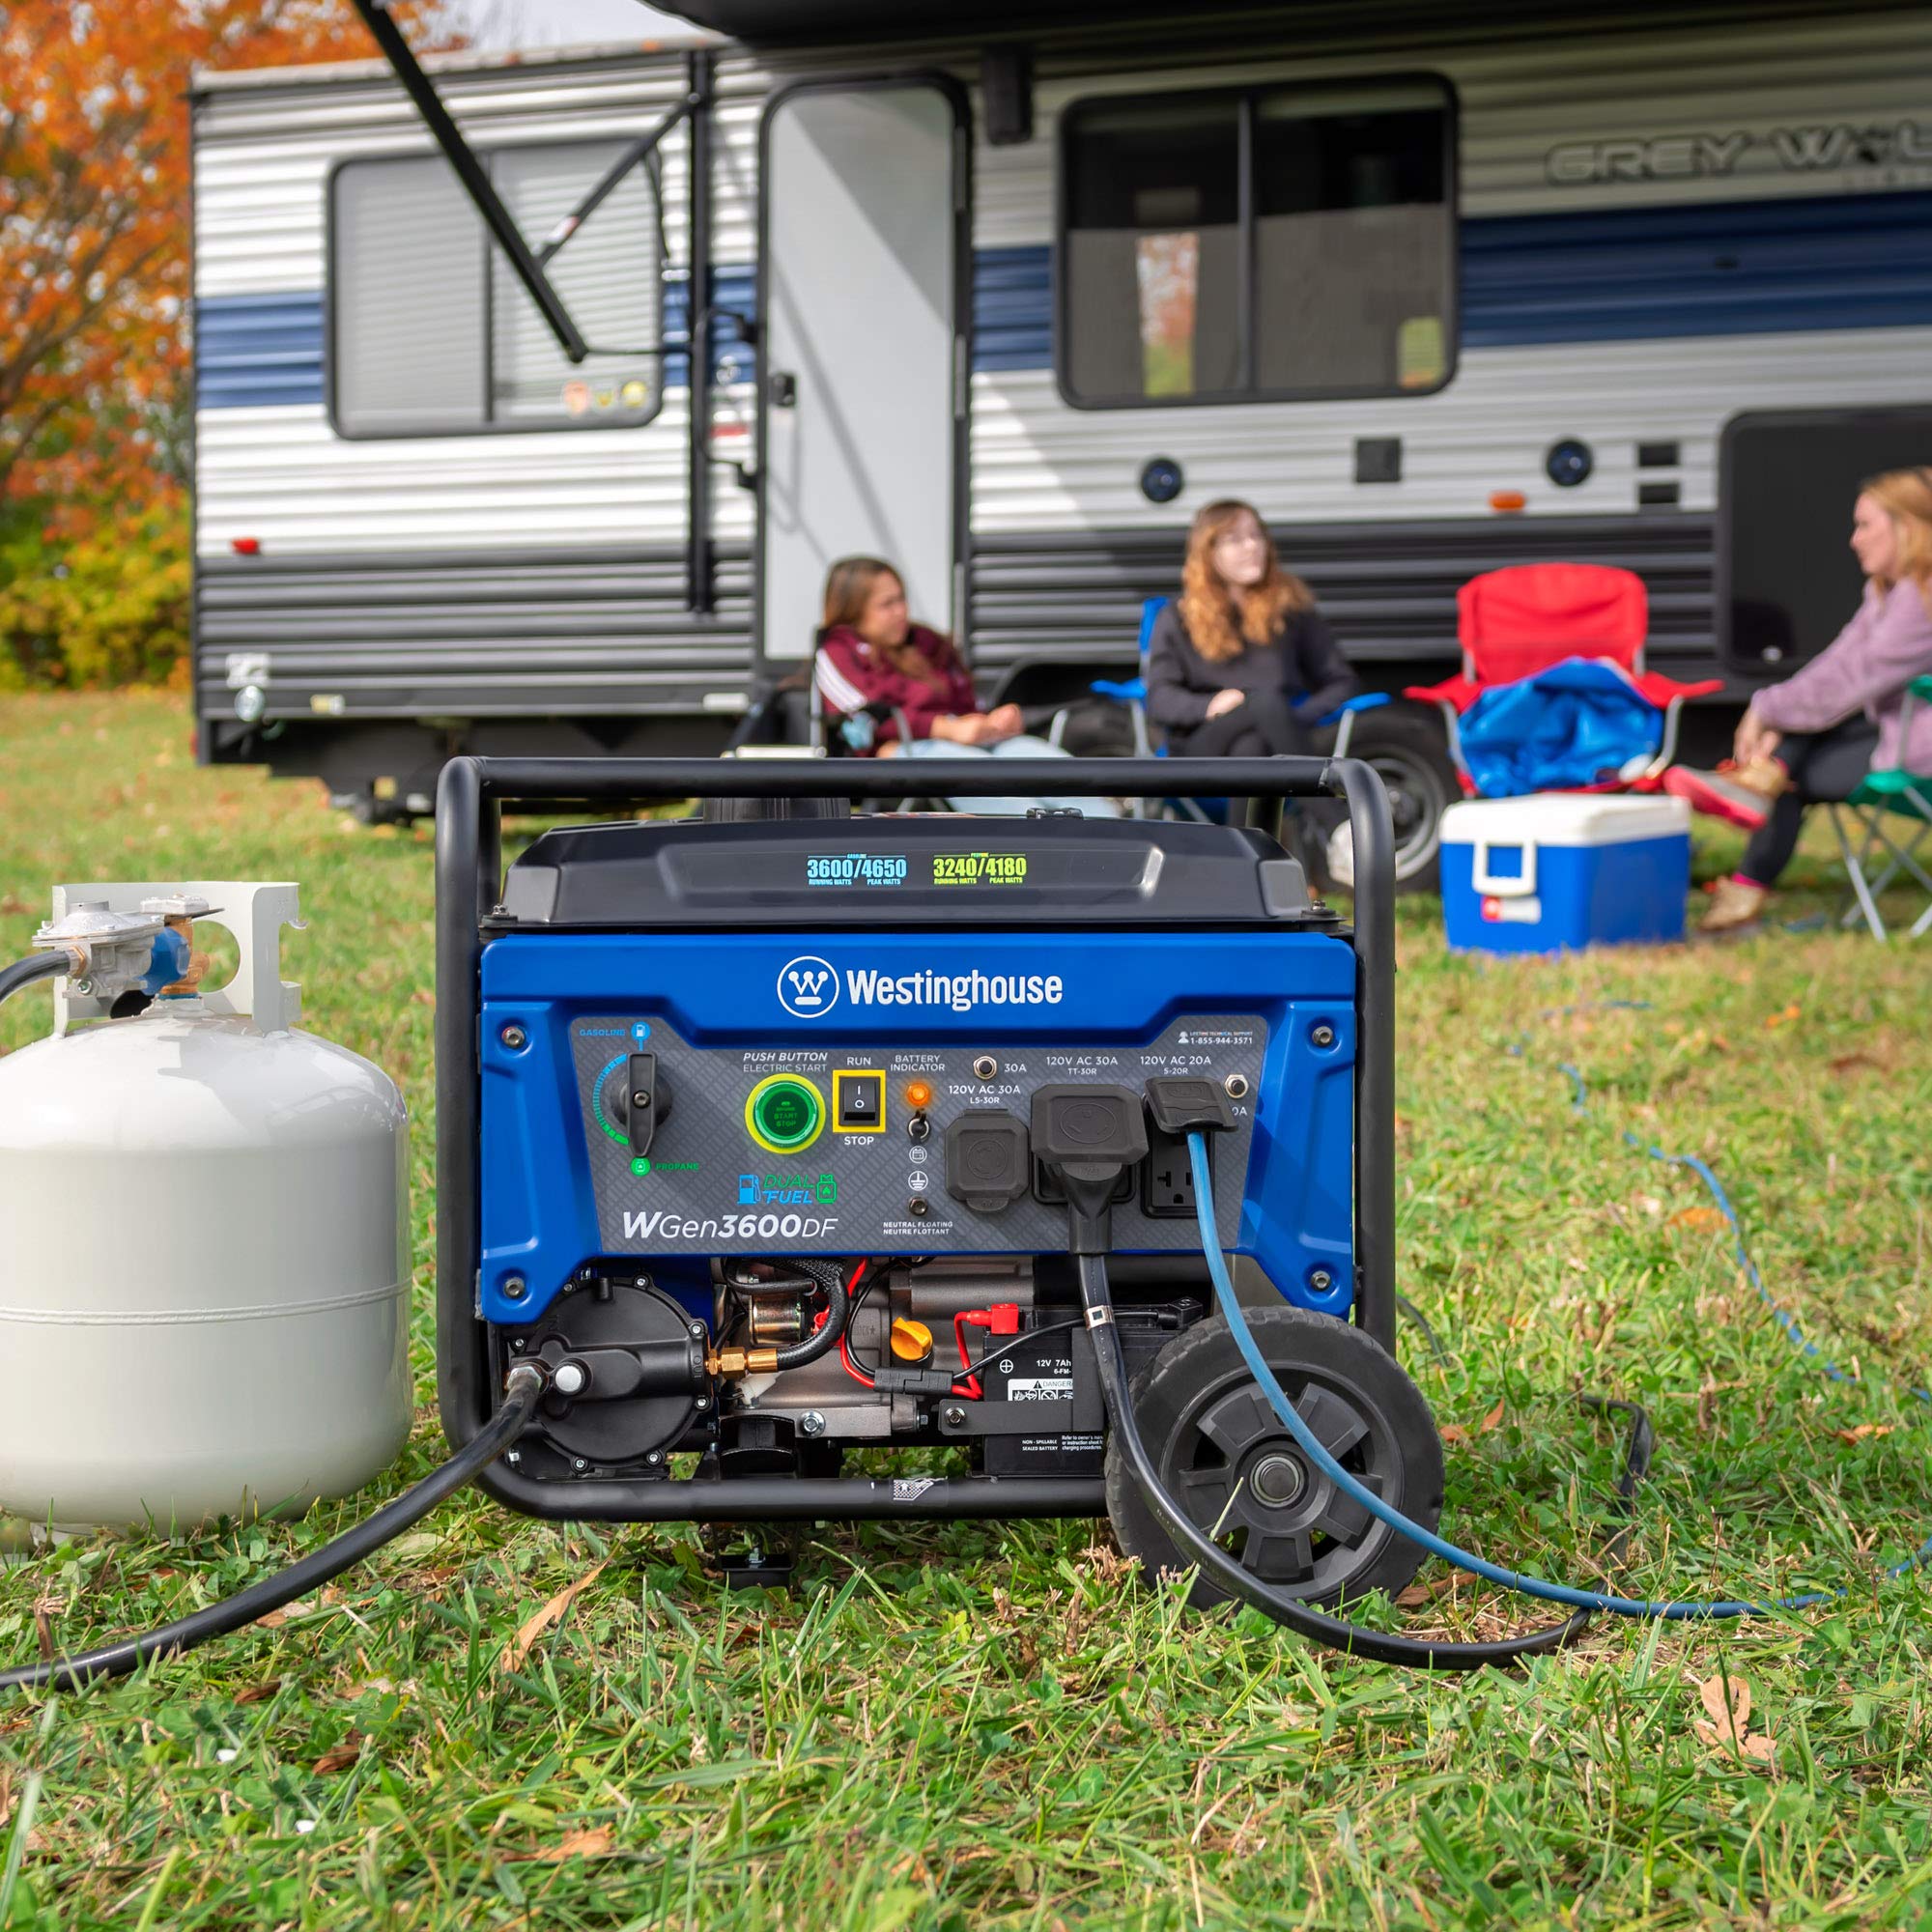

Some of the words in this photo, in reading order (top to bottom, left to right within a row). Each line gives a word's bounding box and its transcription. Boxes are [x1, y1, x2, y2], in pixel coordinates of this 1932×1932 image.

[1547, 129, 1750, 185] GREY
[808, 859, 907, 878] 3600/4650
[933, 857, 1027, 877] 3240/4180
[846, 970, 1063, 1011] Westinghouse
[743, 1052, 776, 1062] PUSH
[779, 1052, 828, 1062] BUTTON
[846, 1057, 871, 1065] RUN
[895, 1055, 941, 1064] BATTERY
[1046, 1057, 1073, 1065] 120V
[1076, 1057, 1093, 1065] AC
[1095, 1057, 1119, 1065] 30A
[1140, 1056, 1167, 1065] 120V
[1170, 1056, 1186, 1065] AC
[1189, 1056, 1212, 1065] 20A
[743, 1064, 793, 1072] ELECTRIC
[795, 1064, 827, 1072] START
[891, 1064, 945, 1072] INDICATOR
[1005, 1064, 1027, 1072] 30A
[949, 1086, 976, 1094] 120V
[979, 1086, 995, 1094] AC
[998, 1086, 1021, 1094] 30A
[1232, 1107, 1248, 1116] 0A
[843, 1136, 874, 1145] STOP
[764, 1175, 814, 1188] DUAL
[762, 1190, 812, 1204] FUEL
[623, 1211, 838, 1238] WGen3600DF
